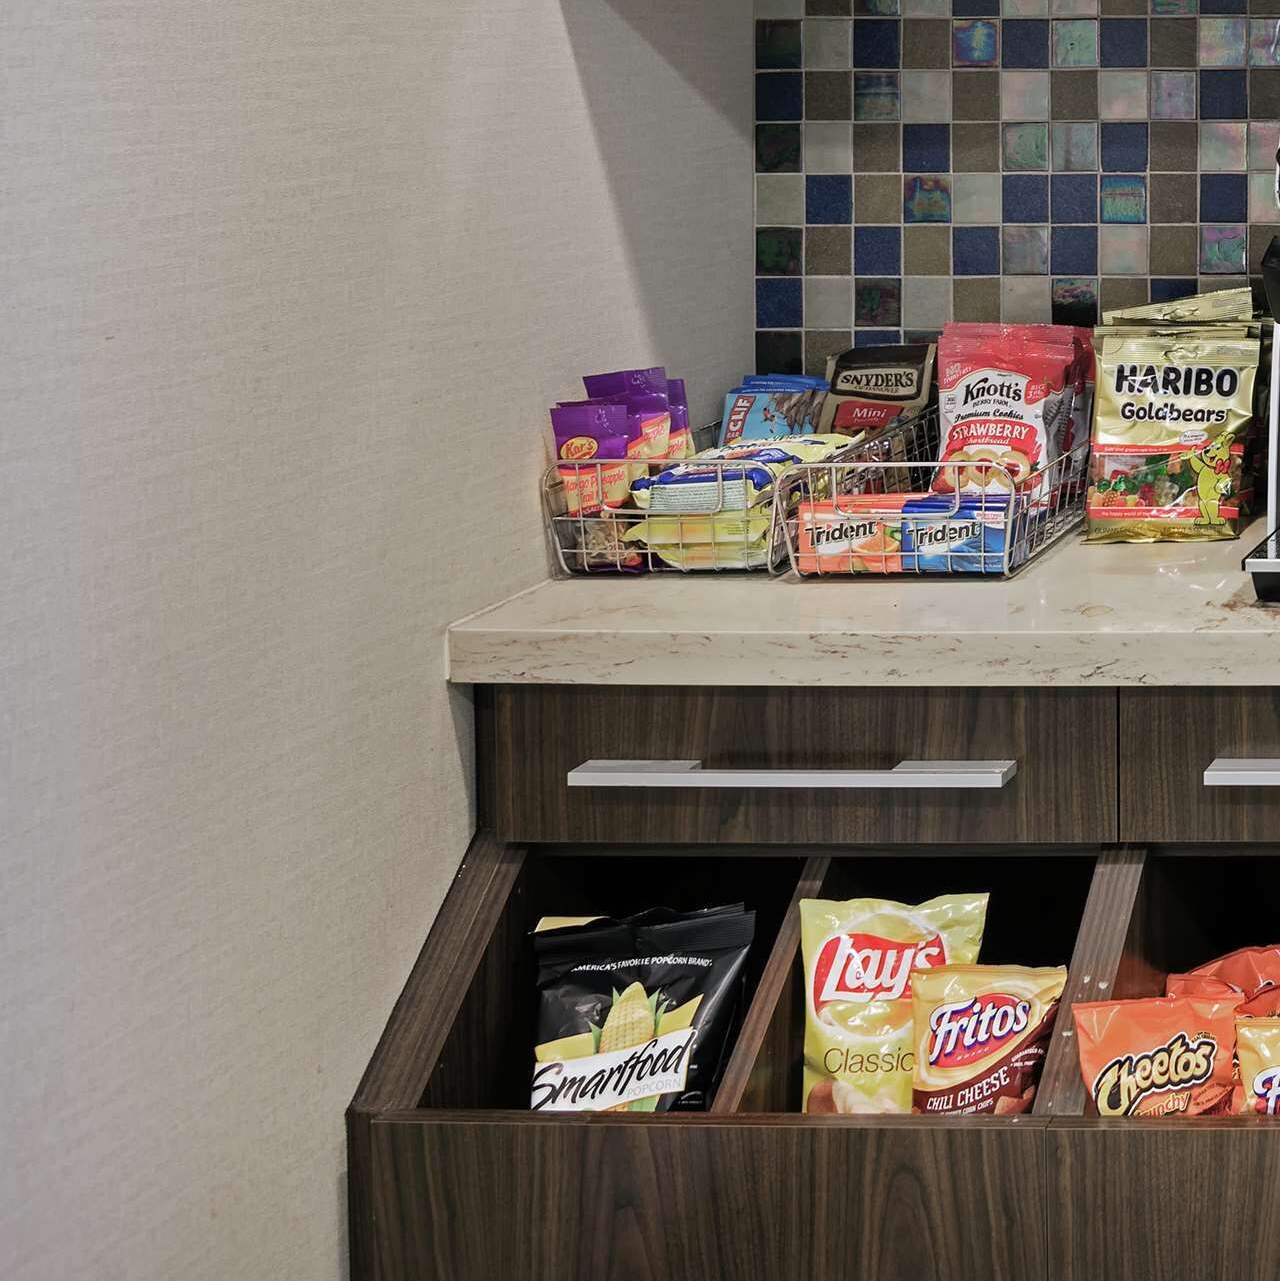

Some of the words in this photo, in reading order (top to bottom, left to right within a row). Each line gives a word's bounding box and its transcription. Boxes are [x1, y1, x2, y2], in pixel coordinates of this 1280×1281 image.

[840, 371, 914, 388] SNYDER'S
[962, 377, 1022, 407] Knott's
[1115, 363, 1239, 398] HARIBO
[728, 396, 751, 433] CLIF
[852, 407, 887, 418] Mini
[954, 410, 991, 423] Premium
[992, 408, 1024, 420] Cookies
[1120, 402, 1227, 423] Goldbears
[952, 423, 1030, 440] STRAWBERRY
[565, 439, 595, 458] Kar's
[805, 521, 876, 547] Trident
[907, 521, 978, 547] Trident
[819, 932, 942, 1002] Lay's
[928, 995, 1032, 1067] Fritos
[531, 1029, 697, 1110] Smartfood
[823, 1046, 915, 1075] Classic
[625, 1077, 683, 1099] POPCORN
[926, 1094, 954, 1111] CHILI
[956, 1065, 1010, 1107] CHEESE
[1095, 1033, 1214, 1116] Cheetos
